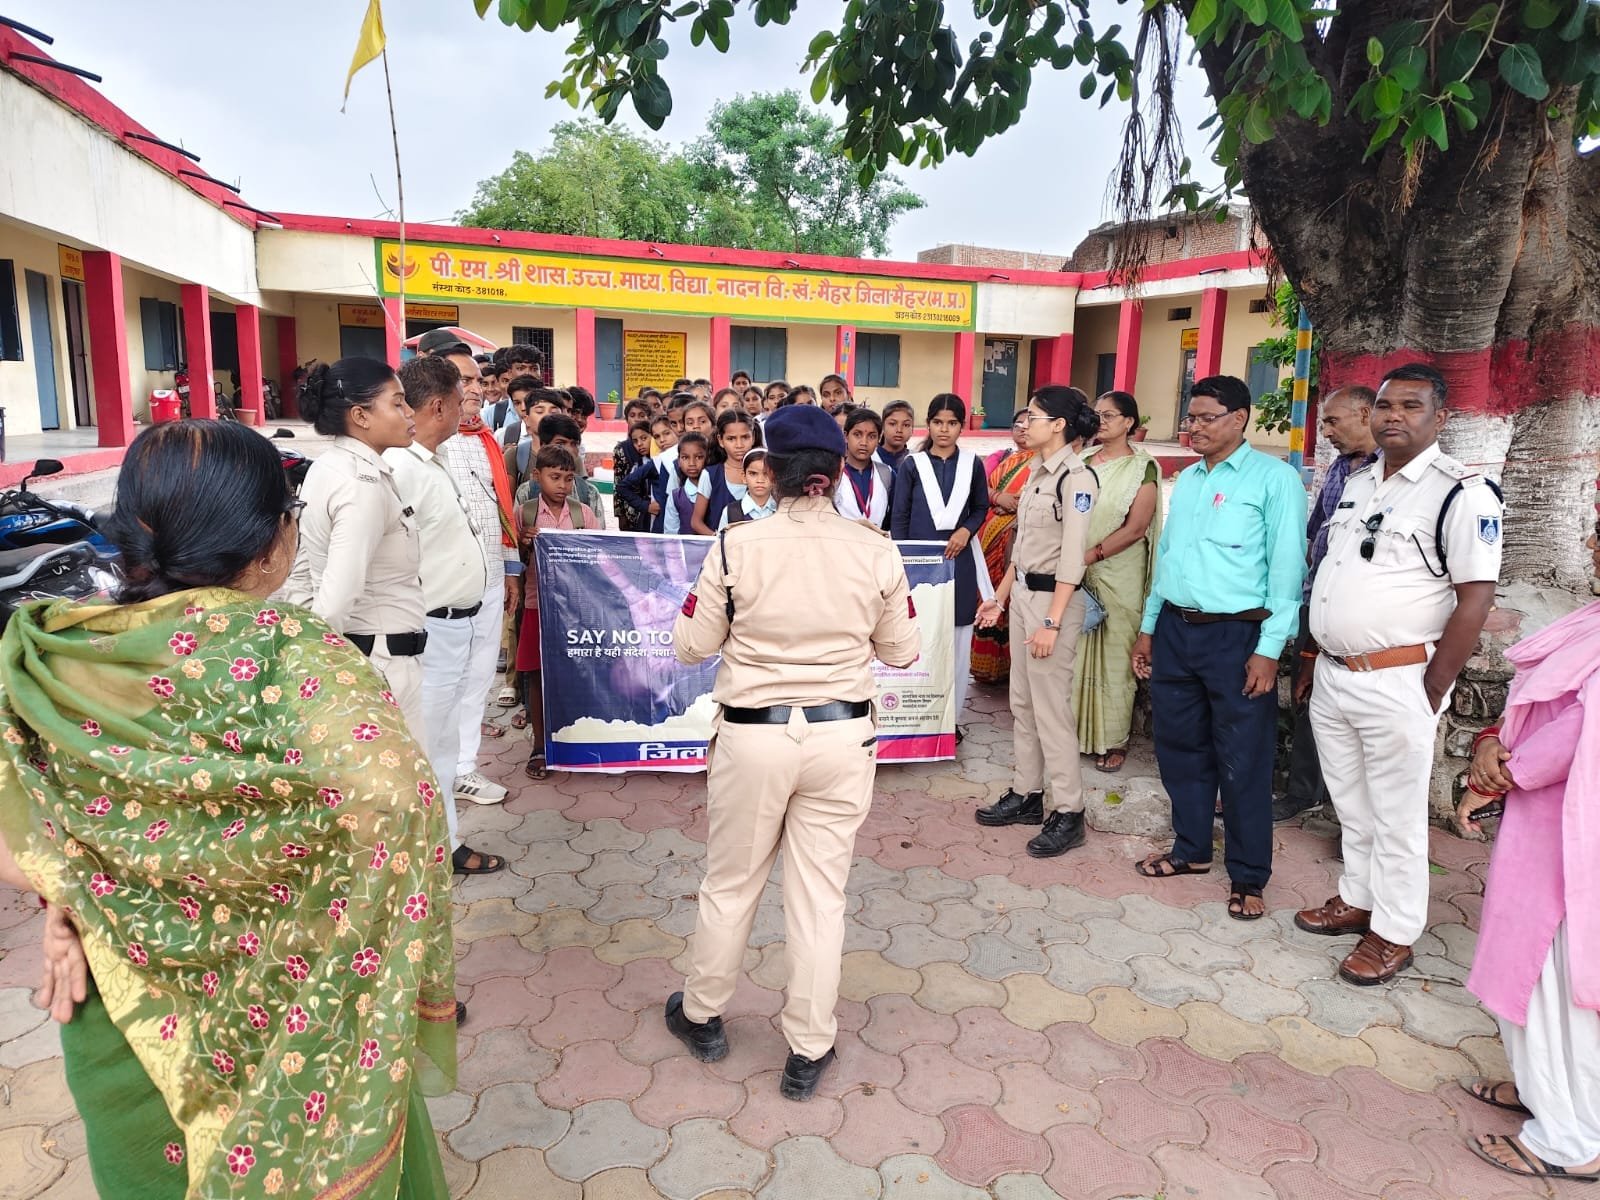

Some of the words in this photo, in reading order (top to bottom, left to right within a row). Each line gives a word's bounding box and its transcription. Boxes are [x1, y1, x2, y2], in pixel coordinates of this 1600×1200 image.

[716, 278, 761, 298] नादन
[566, 629, 605, 644] SAY
[612, 629, 642, 645] NO
[647, 630, 673, 645] TO
[567, 647, 593, 658] हमारा
[594, 645, 602, 658] है
[604, 645, 621, 657] यही
